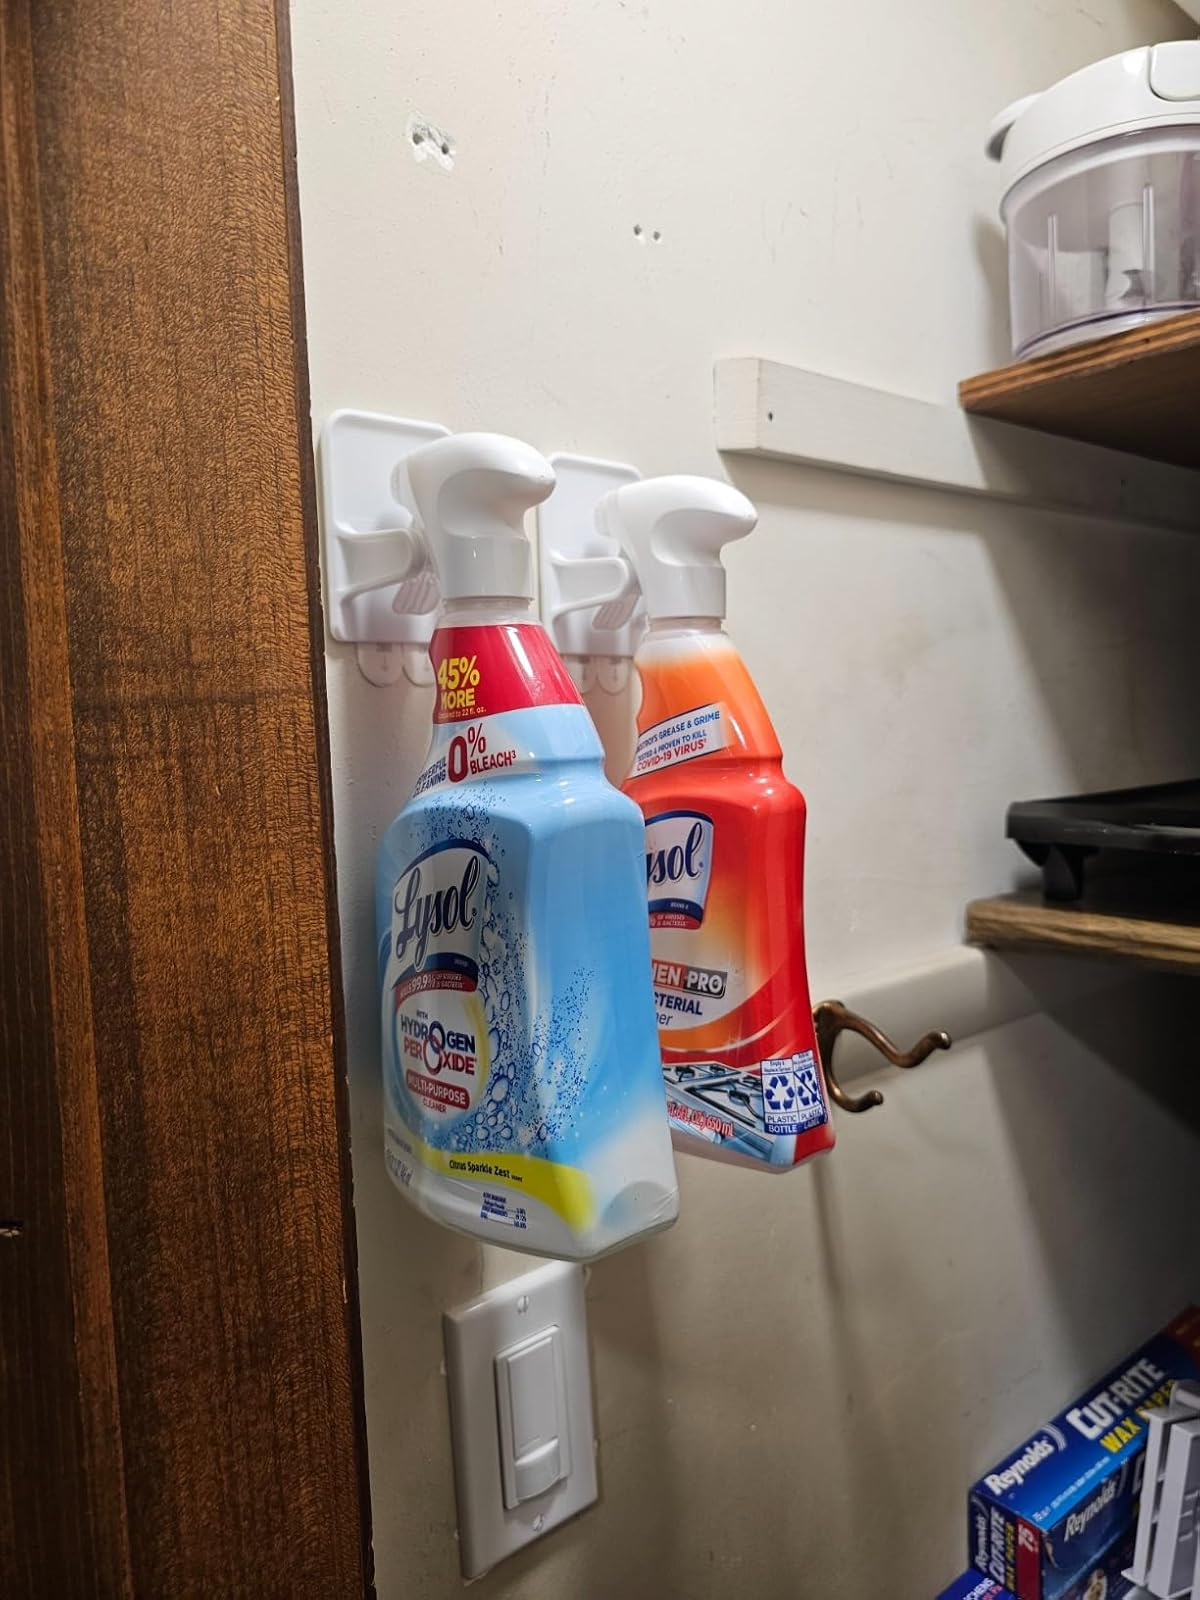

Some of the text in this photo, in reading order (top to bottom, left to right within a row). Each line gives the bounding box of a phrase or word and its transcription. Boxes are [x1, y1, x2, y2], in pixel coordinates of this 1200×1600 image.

[437, 655, 480, 689] 45%
[440, 688, 476, 711] MORE
[462, 708, 470, 717] 22
[658, 740, 681, 753] PROVEN
[682, 734, 692, 743] TO
[692, 729, 707, 739] KILL
[659, 722, 686, 740] GREASE
[687, 720, 693, 729] &
[694, 711, 720, 726] GRIME
[447, 723, 486, 783] 0%
[637, 751, 672, 771] COVID-19
[646, 822, 703, 889] sol
[394, 855, 480, 968] Lysol
[686, 971, 723, 994] PRO
[400, 1014, 475, 1055] HYDROGEN
[407, 1074, 467, 1105] MULTI-PURPOSE
[706, 1115, 721, 1132] 650
[767, 1115, 797, 1124] PLASTIC
[768, 1124, 798, 1134] BOTTLE
[449, 1159, 467, 1171] Citrus
[467, 1161, 493, 1176] Sparkle
[494, 1165, 511, 1179] Zest
[1065, 1358, 1165, 1440] CUT-RITE
[1100, 1416, 1141, 1454] WAX
[984, 1438, 1055, 1495] Reynolds
[1063, 1478, 1117, 1542] Reynolds
[988, 1505, 1006, 1585] CUT-RITE
